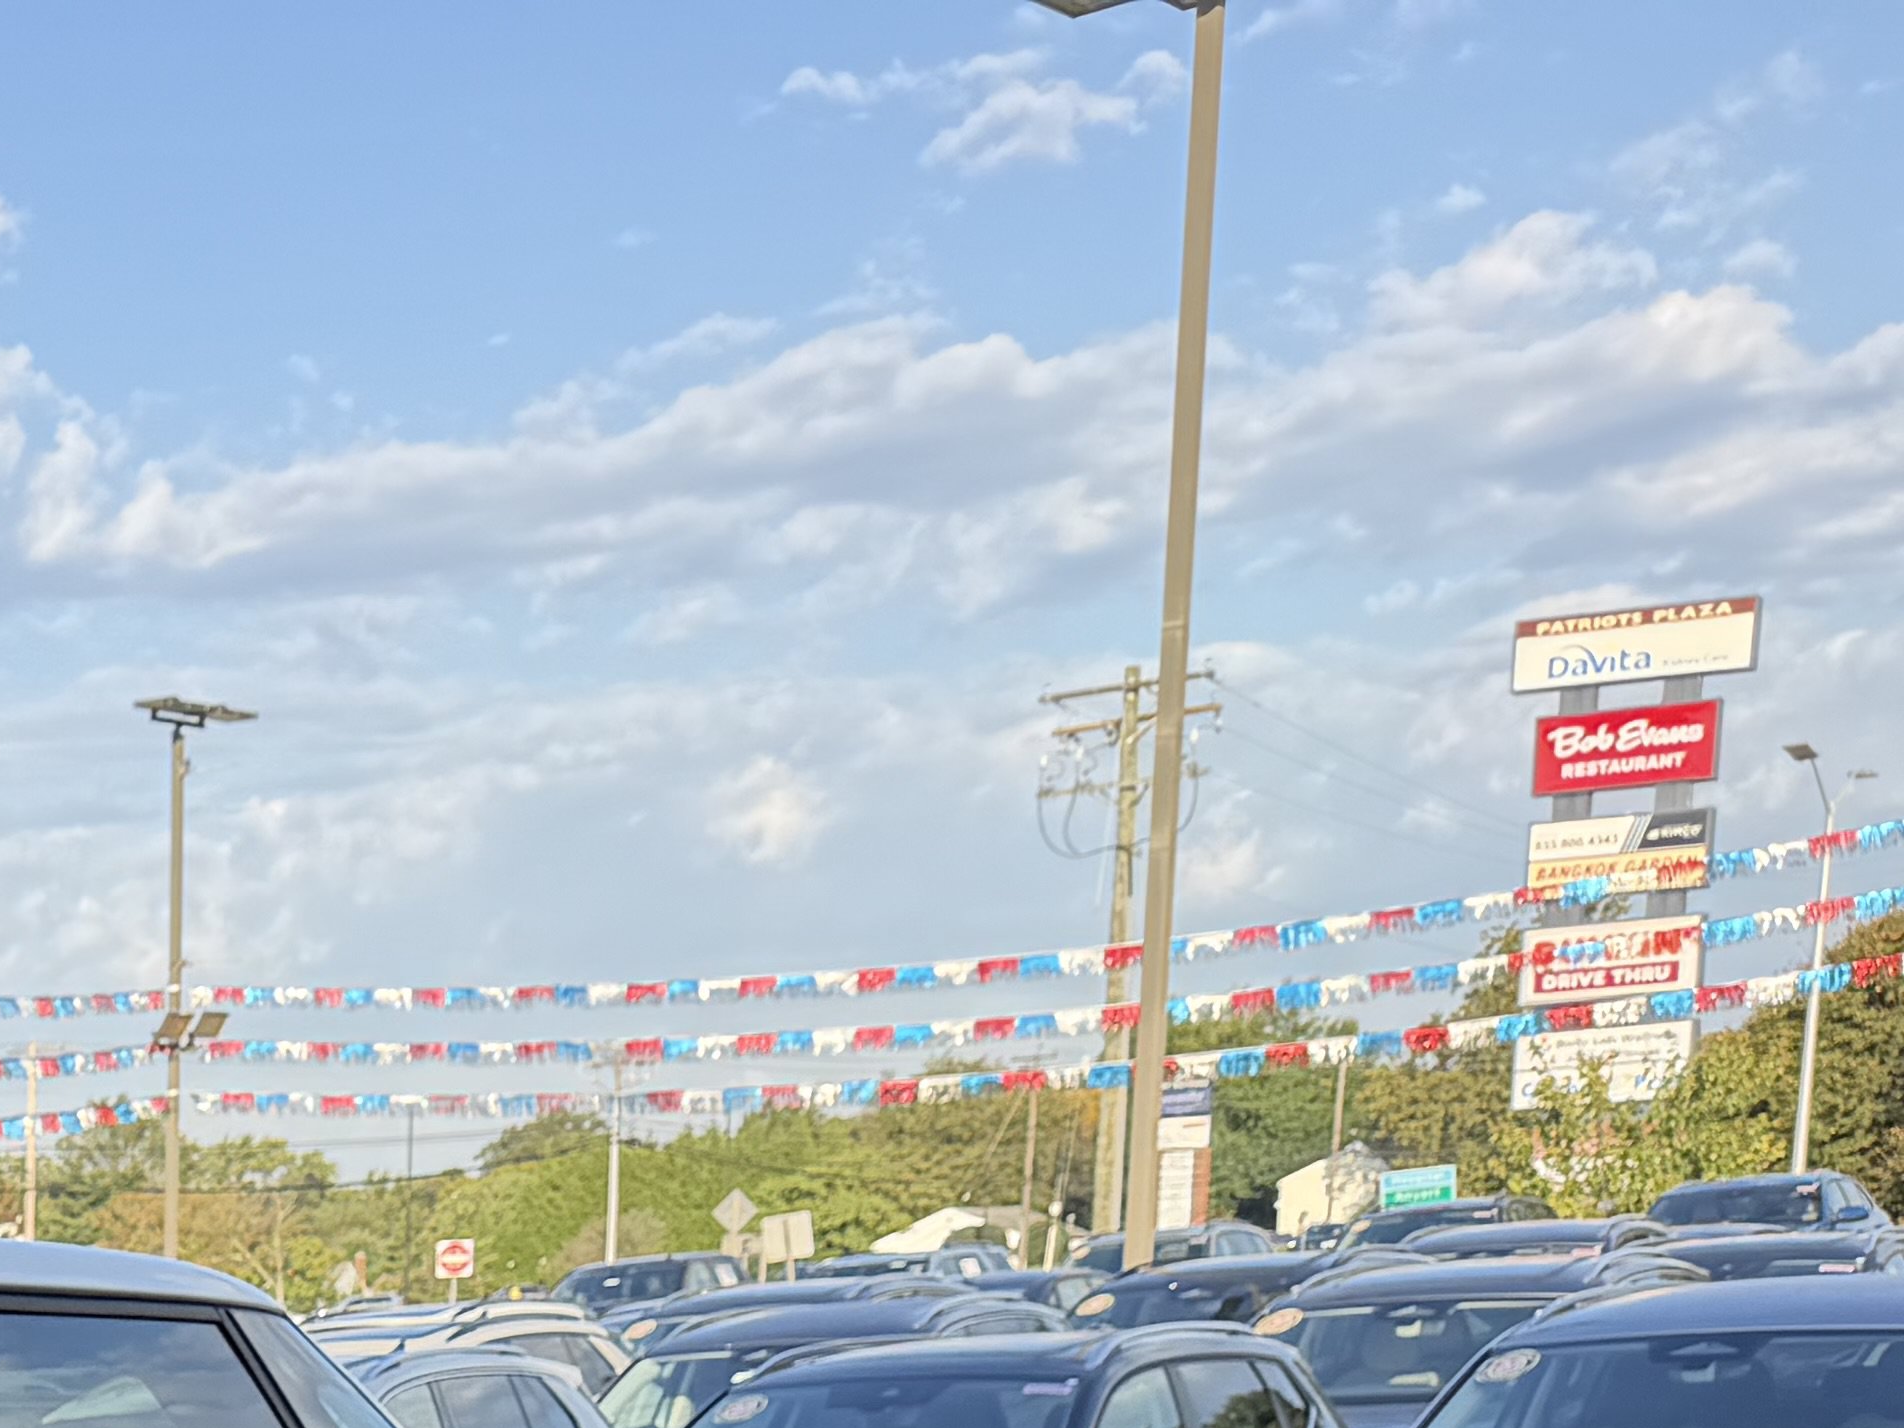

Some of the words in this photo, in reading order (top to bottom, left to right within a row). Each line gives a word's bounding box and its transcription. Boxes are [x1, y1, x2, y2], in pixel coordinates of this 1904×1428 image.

[1535, 611, 1643, 636] PATRIOTS
[1652, 601, 1733, 624] PLAZA
[1547, 646, 1652, 680] DaVita
[1547, 722, 1616, 759] Bob
[1615, 718, 1706, 753] Evans
[1560, 751, 1687, 780] RESTAURANT
[1536, 861, 1617, 881] BANGKOK
[1542, 970, 1607, 991] DRIVE
[1610, 965, 1671, 984] THRU
